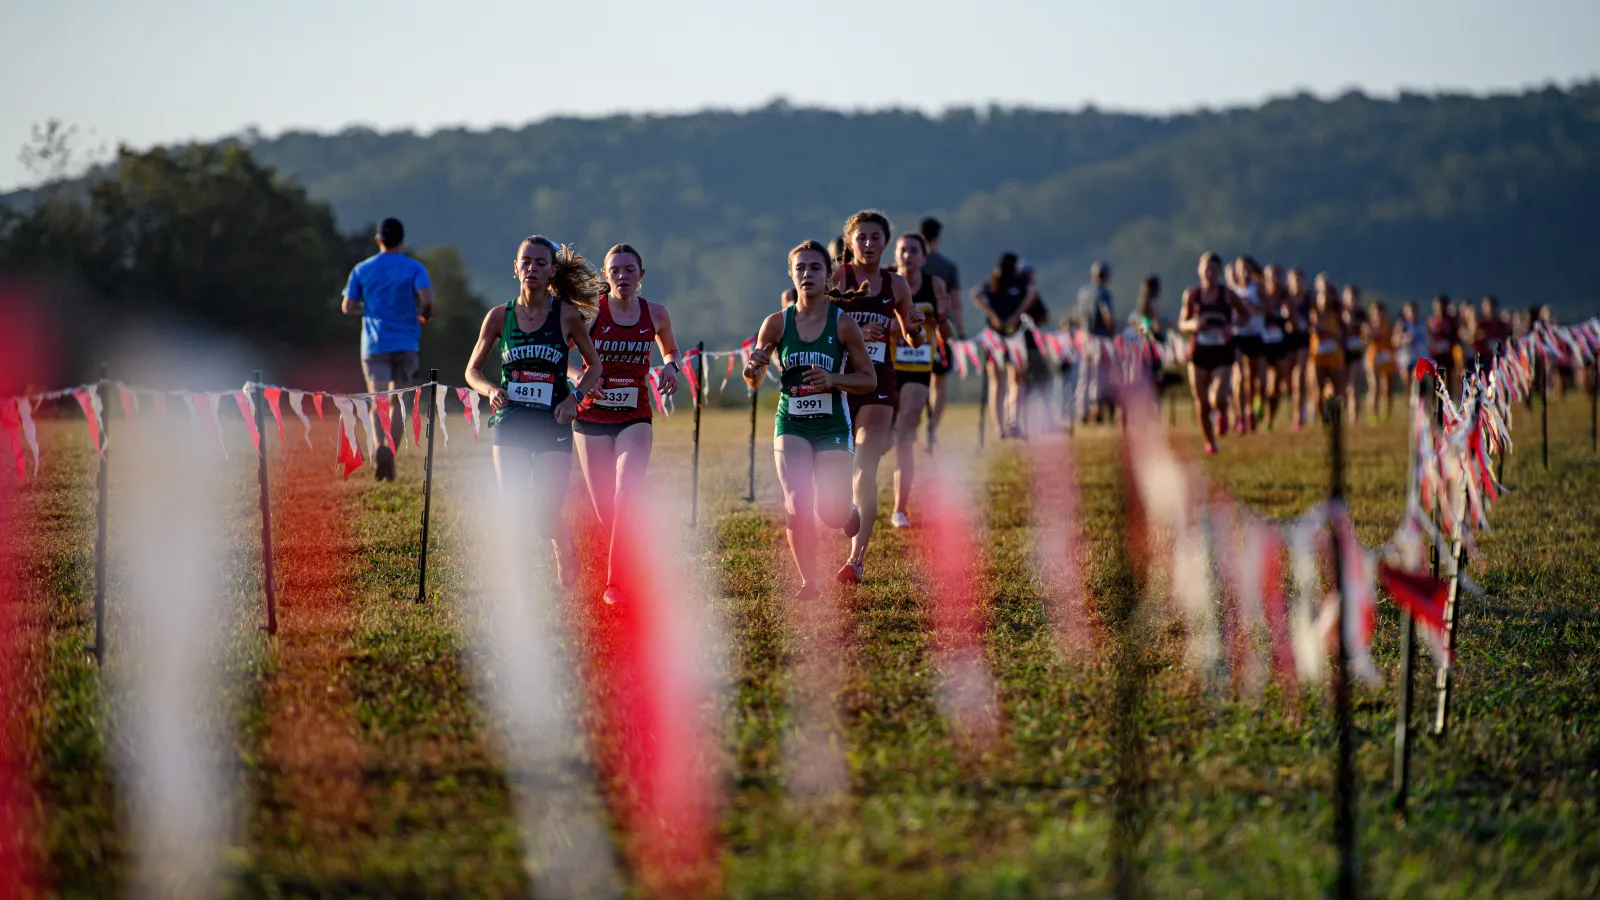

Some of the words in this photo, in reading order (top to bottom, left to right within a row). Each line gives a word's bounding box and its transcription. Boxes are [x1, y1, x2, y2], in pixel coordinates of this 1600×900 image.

[799, 351, 834, 372] HAMILTON
[523, 371, 550, 379] WINGFOOT
[515, 386, 542, 398] 4811
[796, 400, 822, 409] 3991
